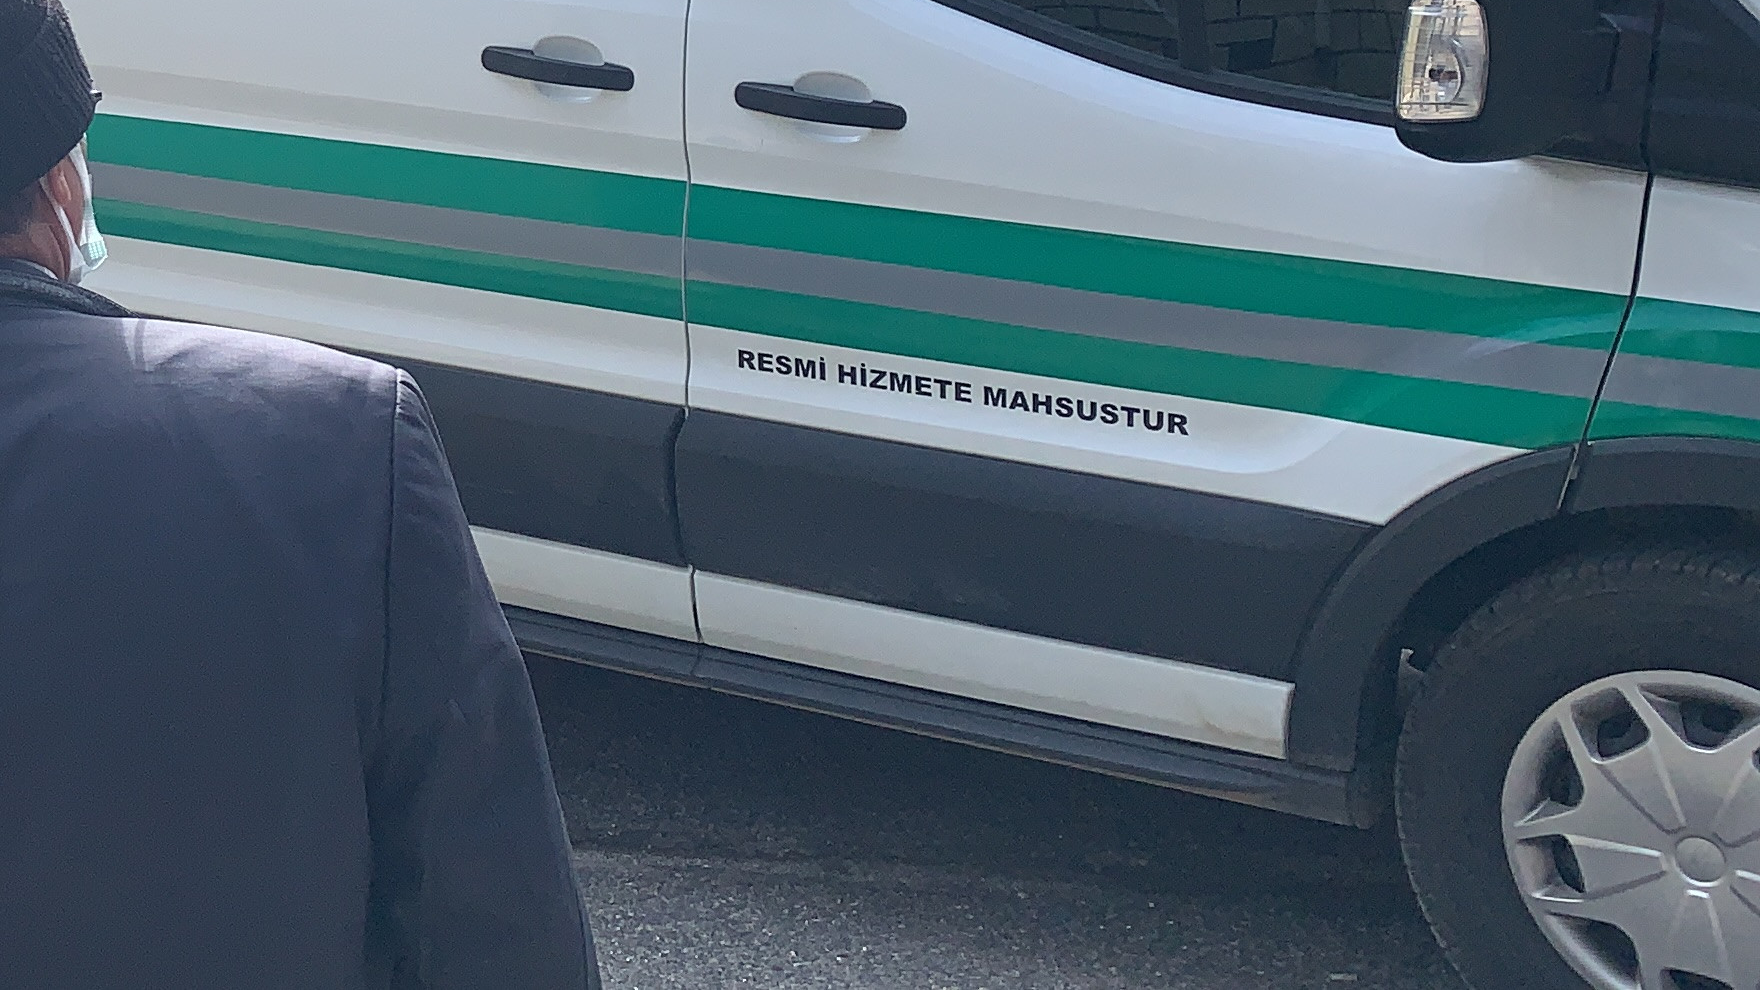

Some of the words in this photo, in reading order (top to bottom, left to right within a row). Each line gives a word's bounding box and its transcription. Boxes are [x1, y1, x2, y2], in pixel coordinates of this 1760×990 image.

[737, 349, 827, 381] RESMİ
[838, 362, 973, 404] HİZMETE
[983, 385, 1190, 436] MAHSUSTUR
